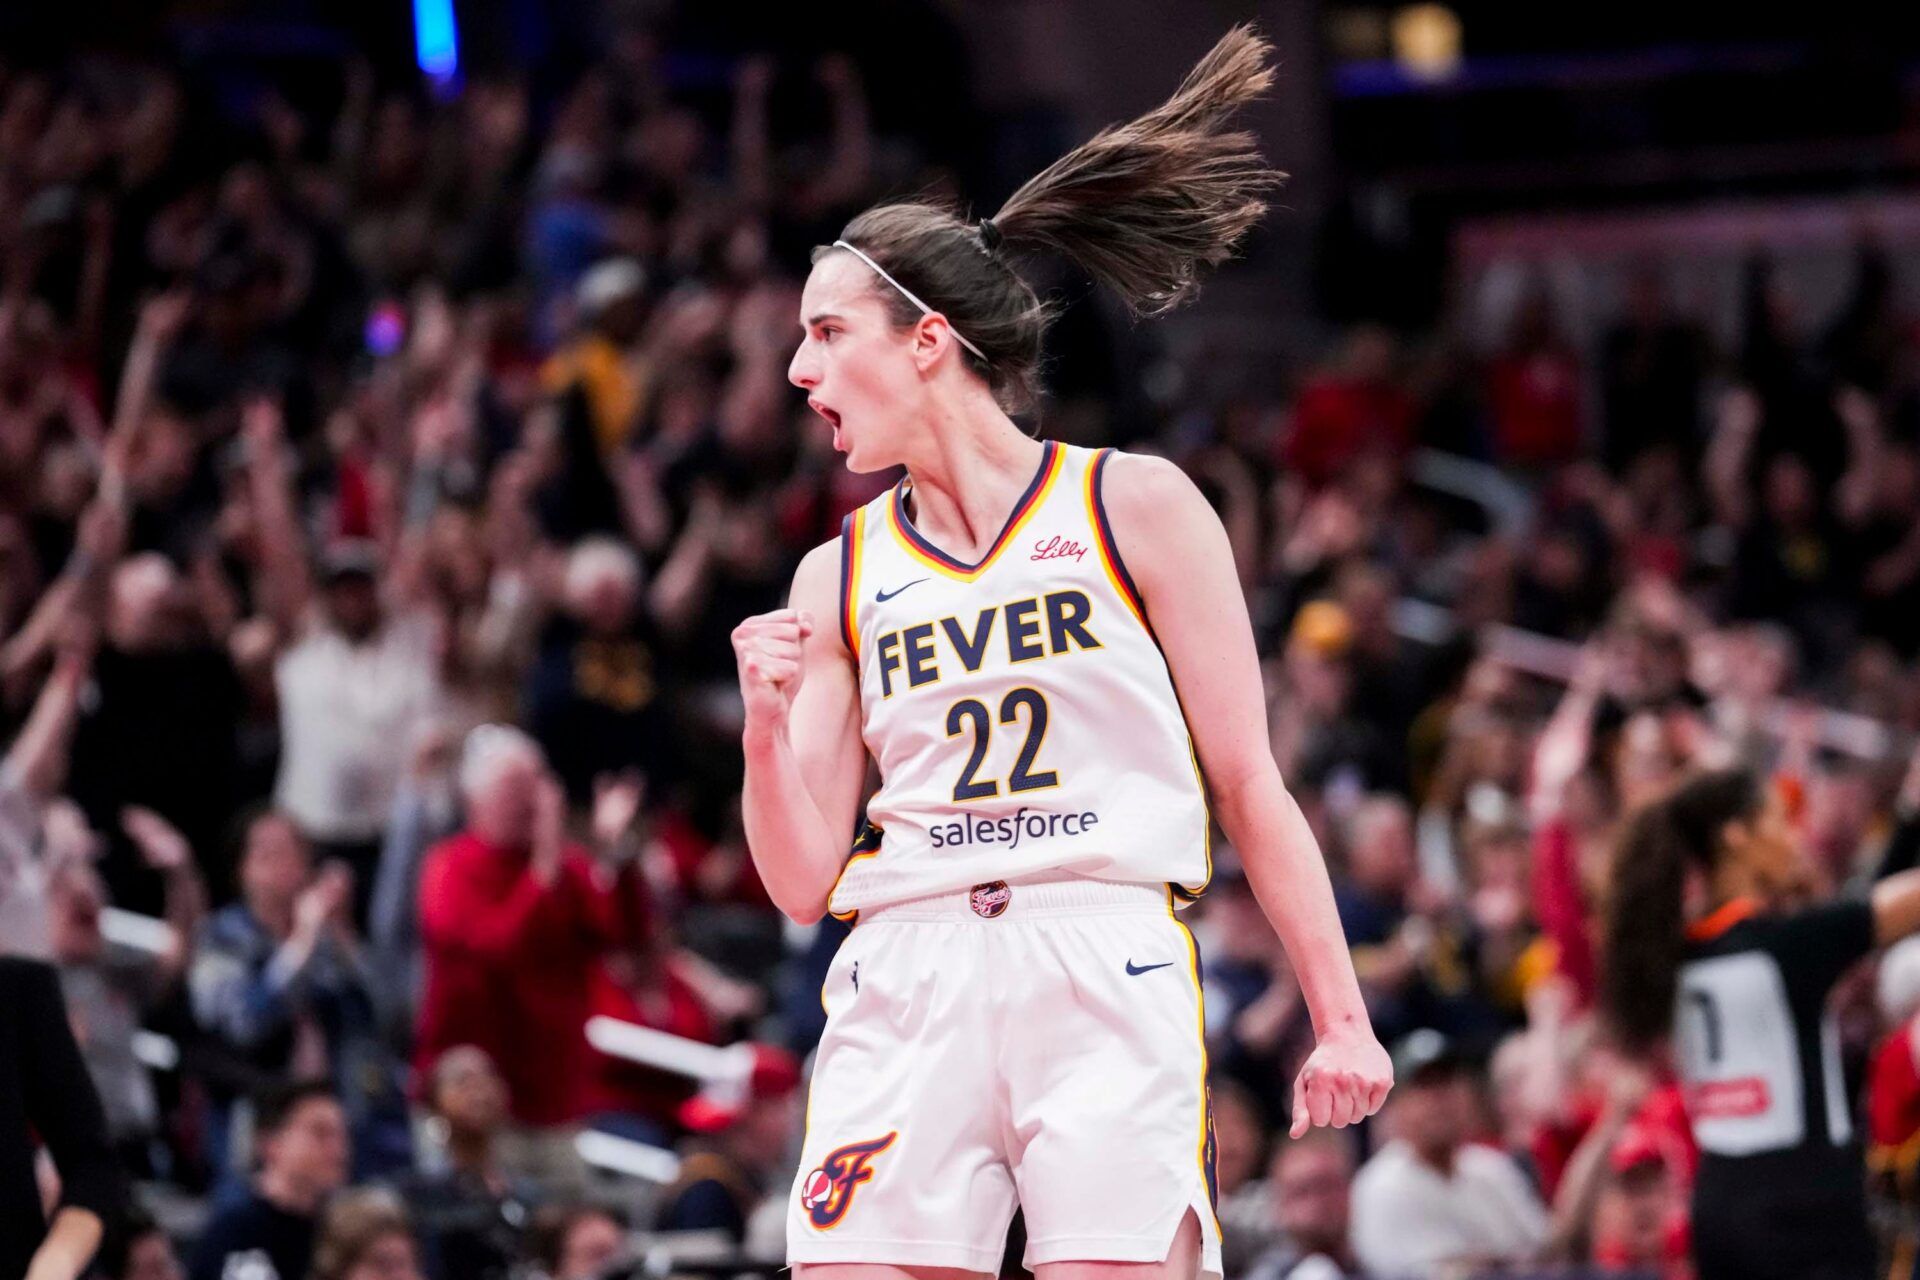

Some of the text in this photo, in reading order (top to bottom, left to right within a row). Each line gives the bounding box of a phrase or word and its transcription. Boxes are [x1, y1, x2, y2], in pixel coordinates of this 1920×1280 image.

[1030, 535, 1088, 562] Lilly
[877, 590, 1105, 699] FEVER
[946, 686, 1060, 803] 22
[930, 807, 1098, 849] salesforce
